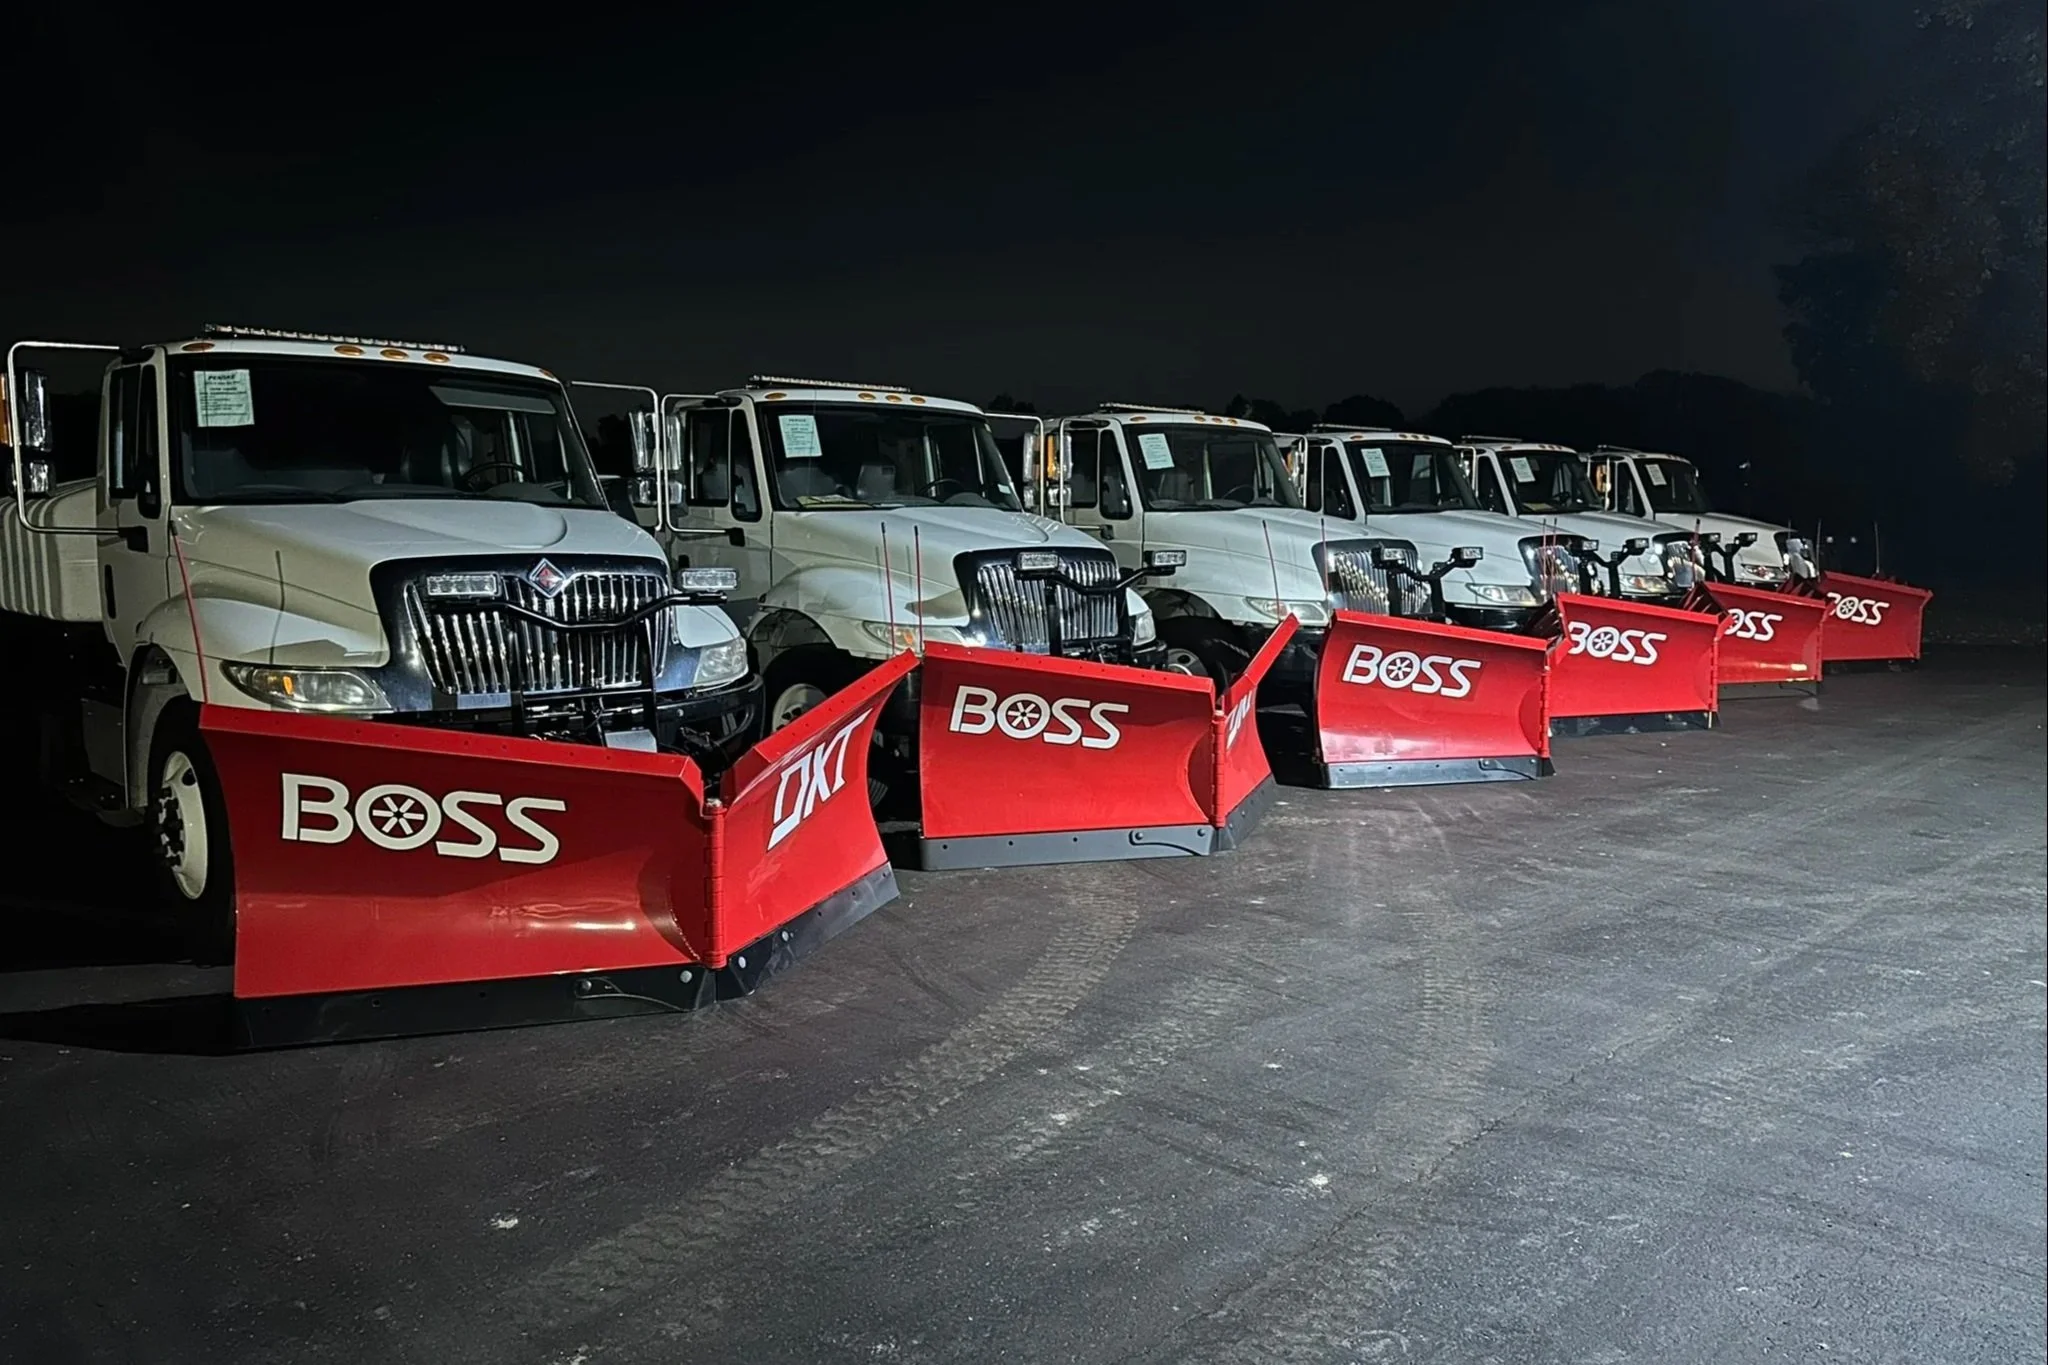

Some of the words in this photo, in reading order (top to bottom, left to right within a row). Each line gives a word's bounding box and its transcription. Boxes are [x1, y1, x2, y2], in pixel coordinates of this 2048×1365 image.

[1342, 644, 1482, 699] BOSS
[949, 685, 1130, 750] BOSS
[282, 772, 567, 865] BOSS
[767, 708, 873, 851] DXT
